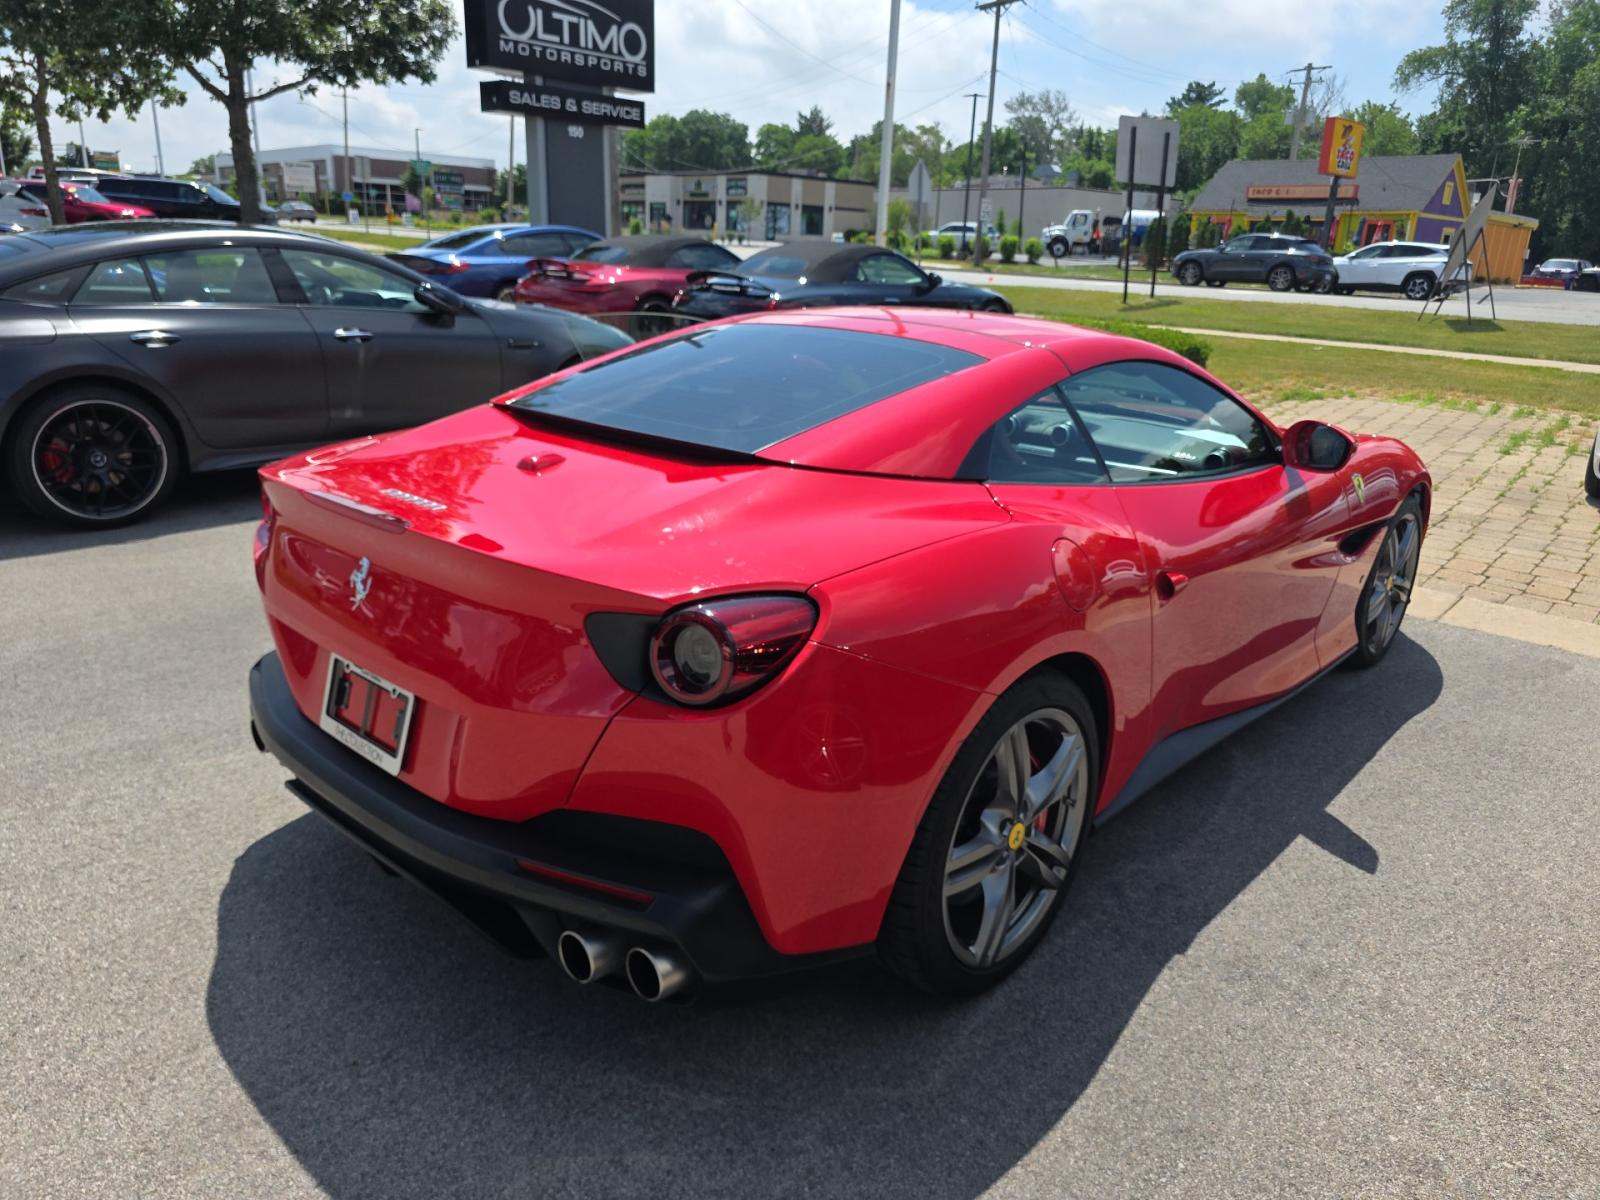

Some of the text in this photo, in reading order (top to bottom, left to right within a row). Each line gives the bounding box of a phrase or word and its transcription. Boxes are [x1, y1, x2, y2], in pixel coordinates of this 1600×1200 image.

[500, 40, 648, 77] MOTORSPORTS
[509, 89, 641, 121] SALES & SERVICE
